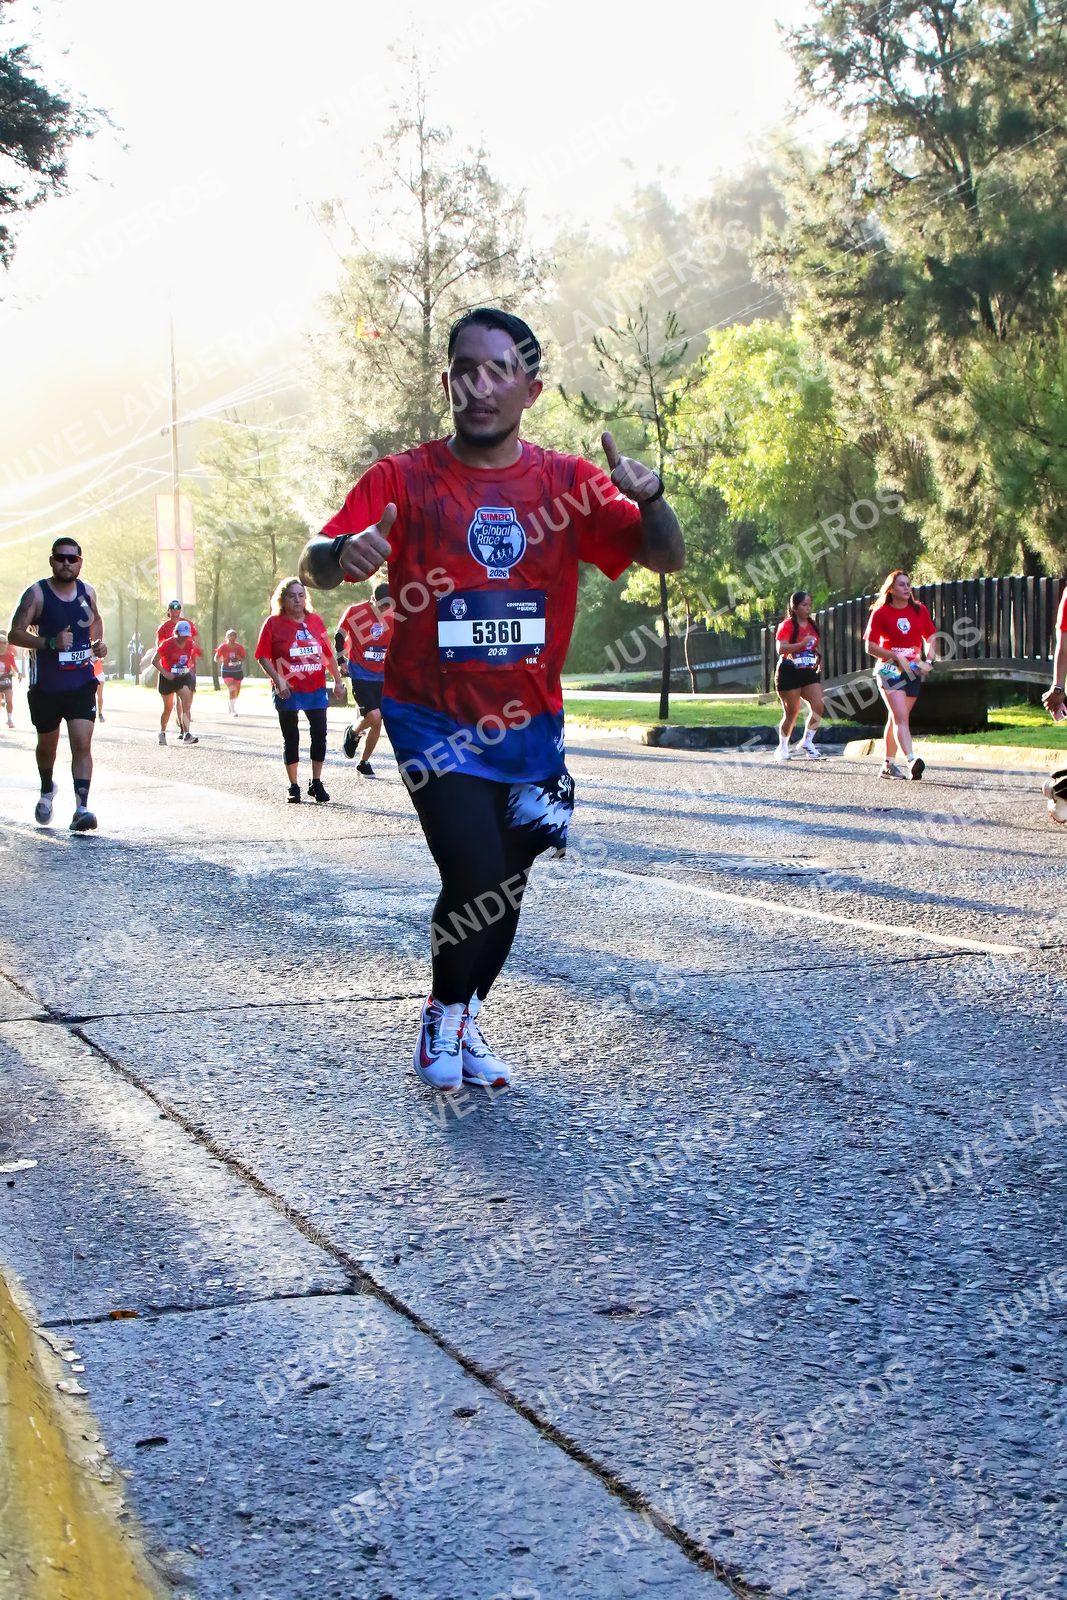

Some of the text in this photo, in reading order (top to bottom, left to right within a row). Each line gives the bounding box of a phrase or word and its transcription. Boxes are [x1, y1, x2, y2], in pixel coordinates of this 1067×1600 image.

[481, 513, 512, 522] BIMBO
[482, 525, 511, 536] Global
[477, 534, 500, 546] Race
[489, 569, 508, 578] 2026
[472, 620, 521, 645] 5360
[299, 646, 314, 655] 3434
[525, 657, 538, 665] 10K
[289, 663, 322, 673] SANTIAGO
